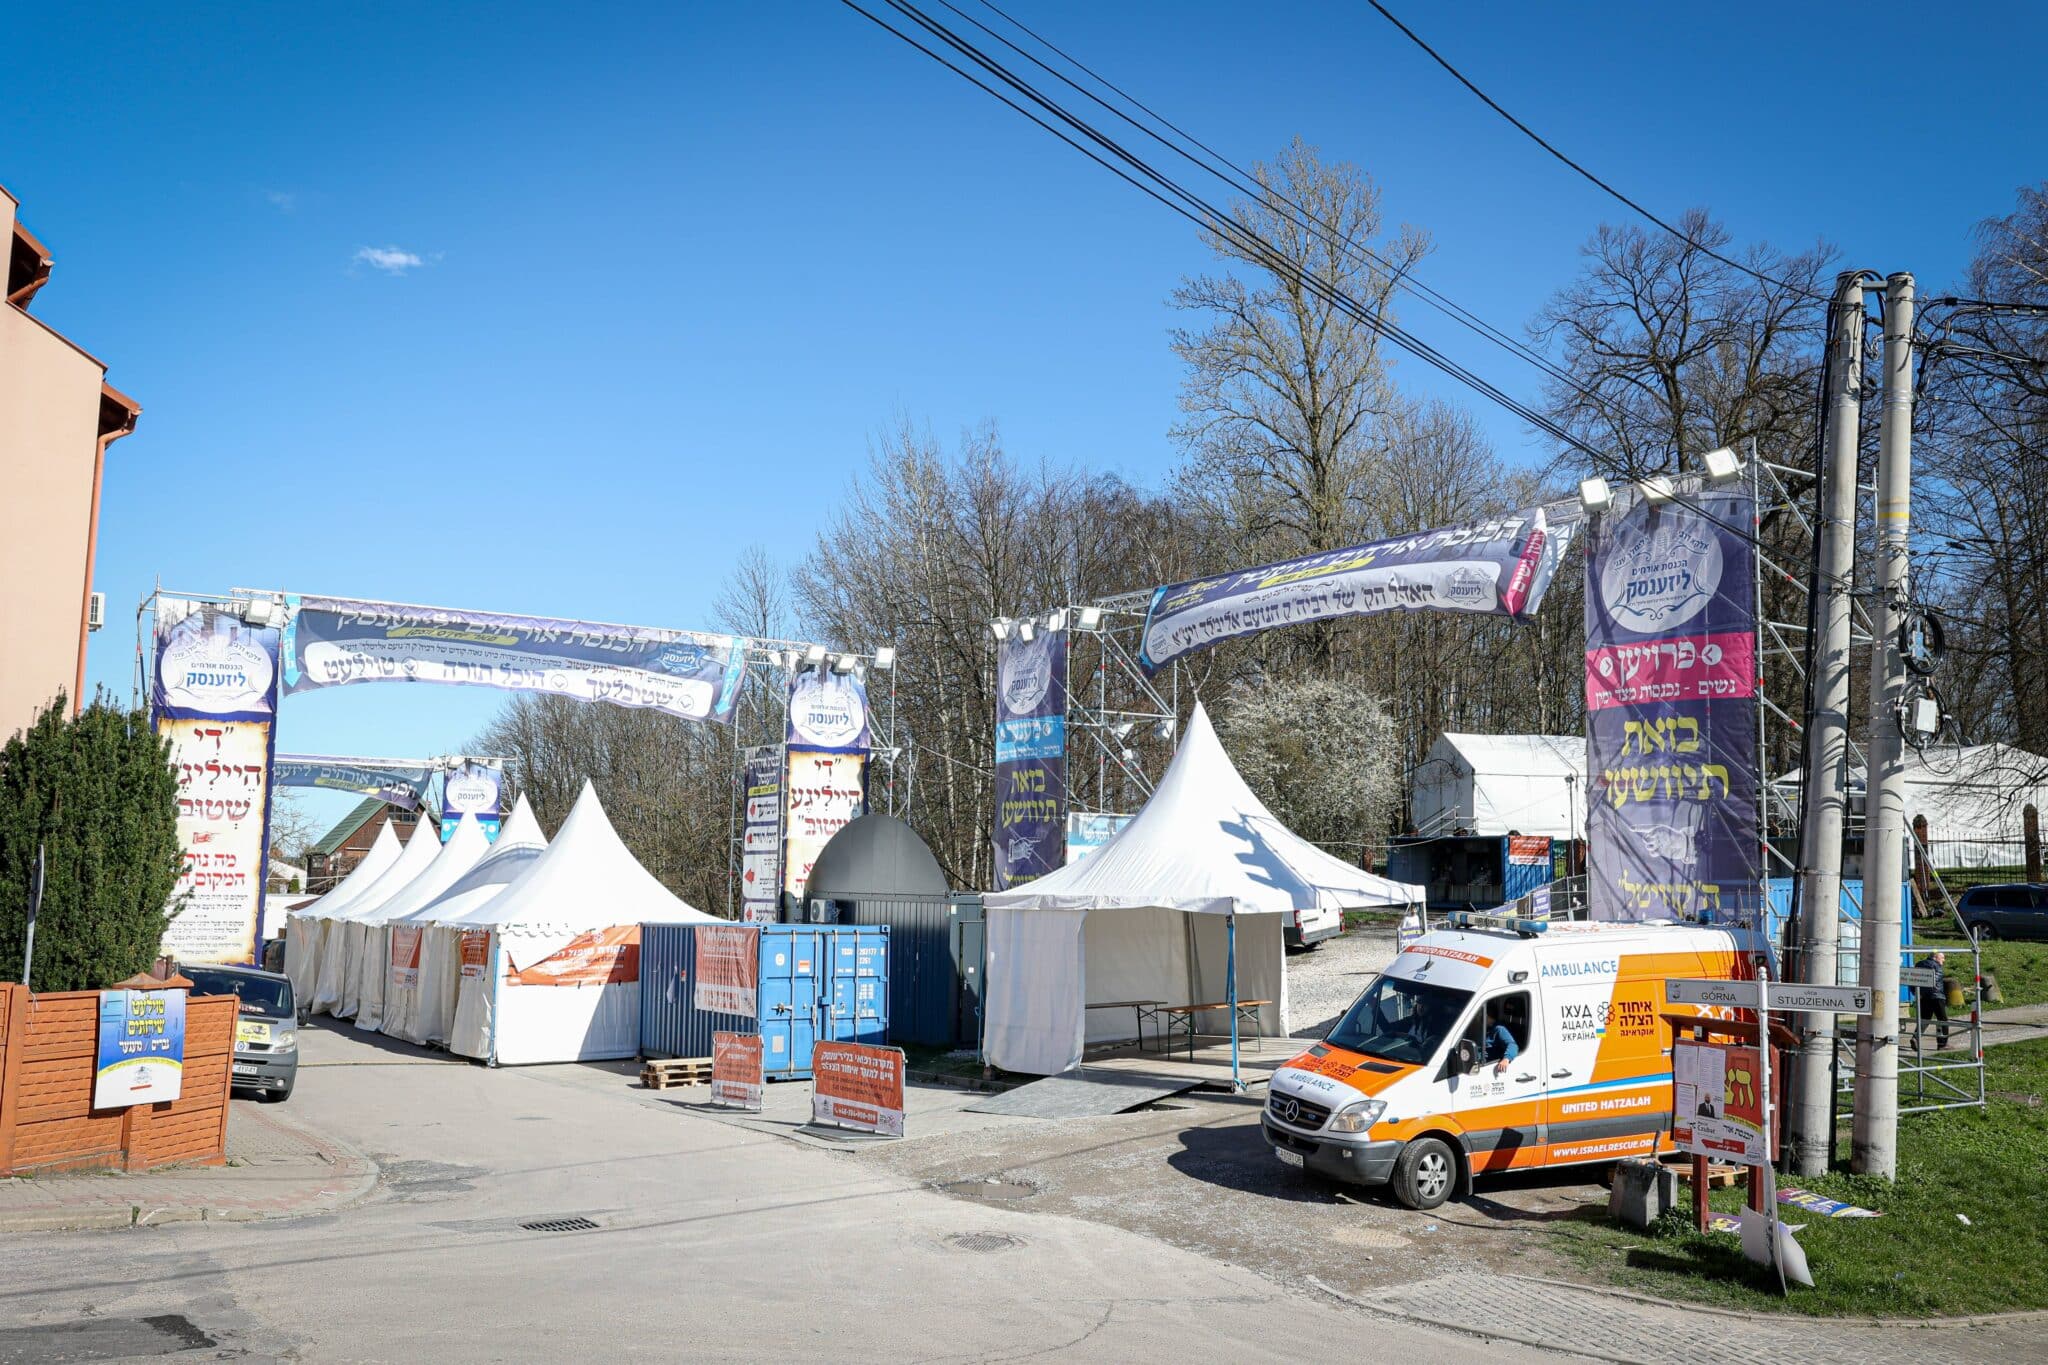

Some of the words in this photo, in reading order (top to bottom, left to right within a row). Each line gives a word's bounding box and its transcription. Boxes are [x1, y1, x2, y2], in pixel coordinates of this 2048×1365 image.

[1632, 564, 1659, 576] אורחים
[1661, 560, 1688, 570] הכנסת
[1626, 569, 1691, 603] ליזענסק
[563, 631, 649, 653] הכנסת
[443, 660, 493, 681] תורה
[1617, 641, 1696, 686] פרויען
[186, 671, 247, 688] ליזענסק
[1011, 672, 1038, 691] ליזענסק
[1699, 679, 1736, 695] נשים
[1640, 682, 1681, 700] נכנסות
[808, 712, 849, 726] ליזענסק
[1541, 960, 1618, 977] AMBULANCE
[1701, 991, 1737, 1002] GÓRNA
[1777, 995, 1846, 1008] STUDZIENNA
[1618, 1001, 1653, 1013] איחוד
[1562, 1019, 1595, 1030] АЦАЛА
[1620, 1014, 1654, 1026] הצלה
[1562, 1031, 1596, 1042] УКРАЇНА
[1620, 1029, 1655, 1037] אוקראינה
[1289, 1073, 1336, 1091] AMBULANCE
[1562, 1101, 1598, 1114] UNITED
[1600, 1096, 1652, 1111] HATZALAH
[1553, 1138, 1659, 1158] WWW.ISRAELRESCUE.OR
